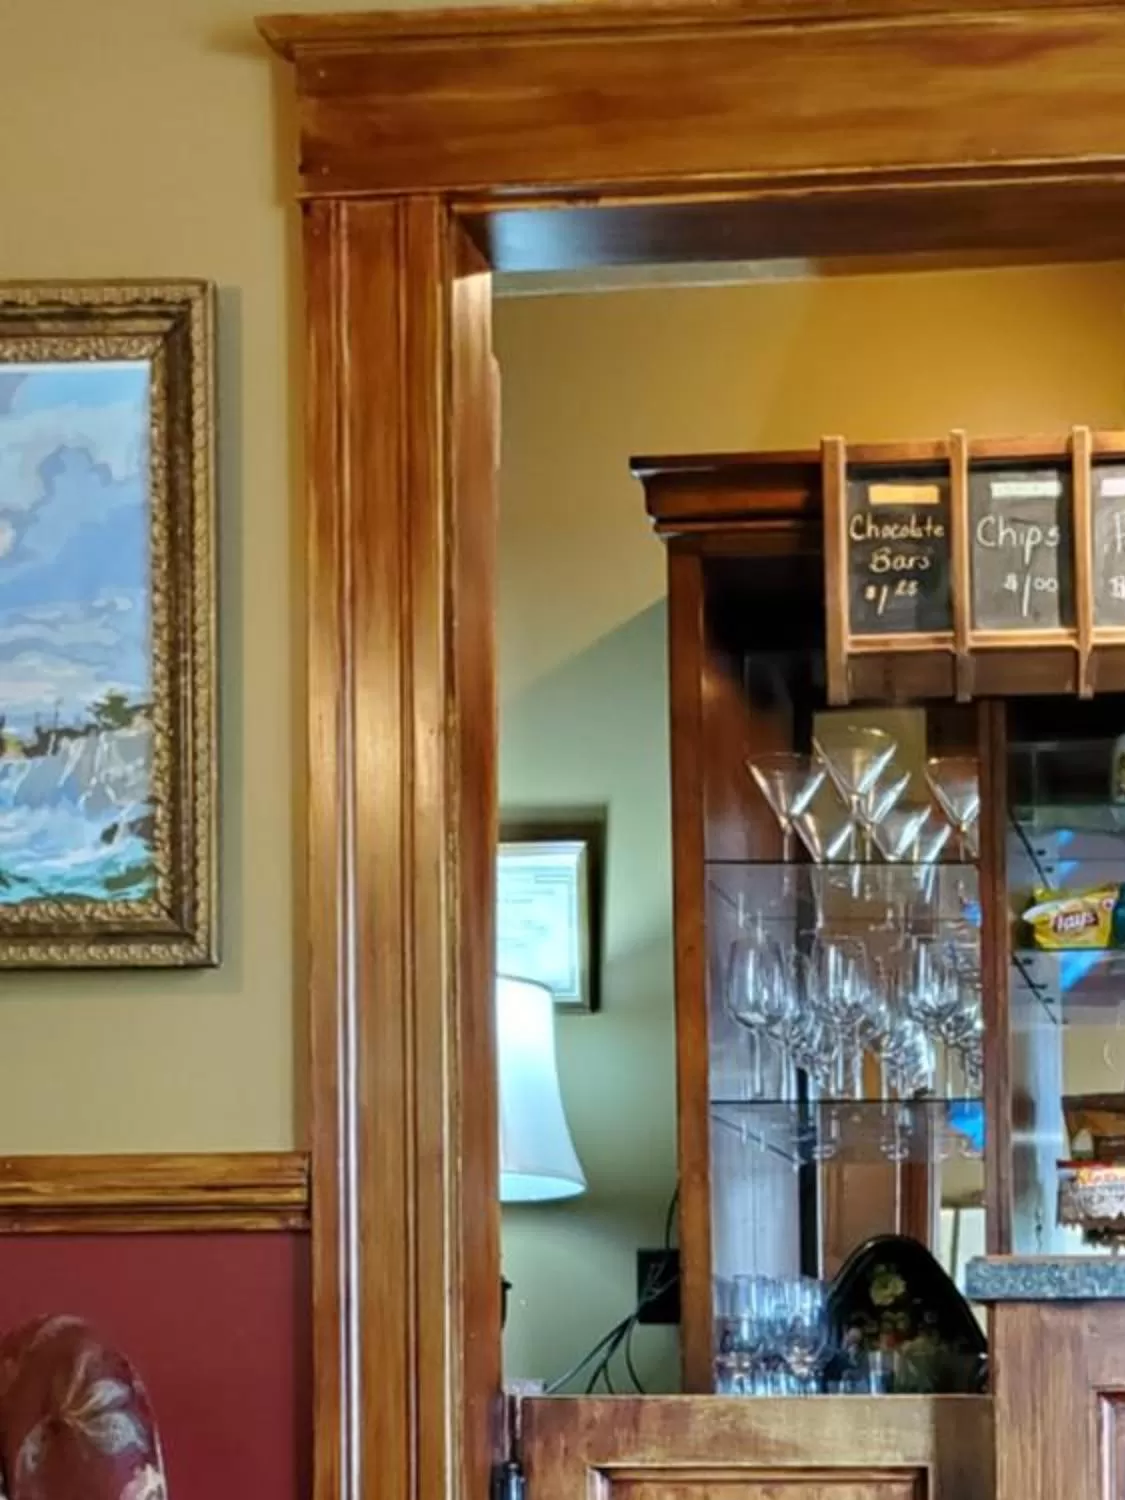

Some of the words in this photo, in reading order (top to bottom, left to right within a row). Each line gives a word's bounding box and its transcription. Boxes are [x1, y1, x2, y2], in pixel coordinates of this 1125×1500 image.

[849, 513, 945, 541] Chocolate
[976, 515, 1060, 566] Chips
[869, 549, 930, 572] Bars
